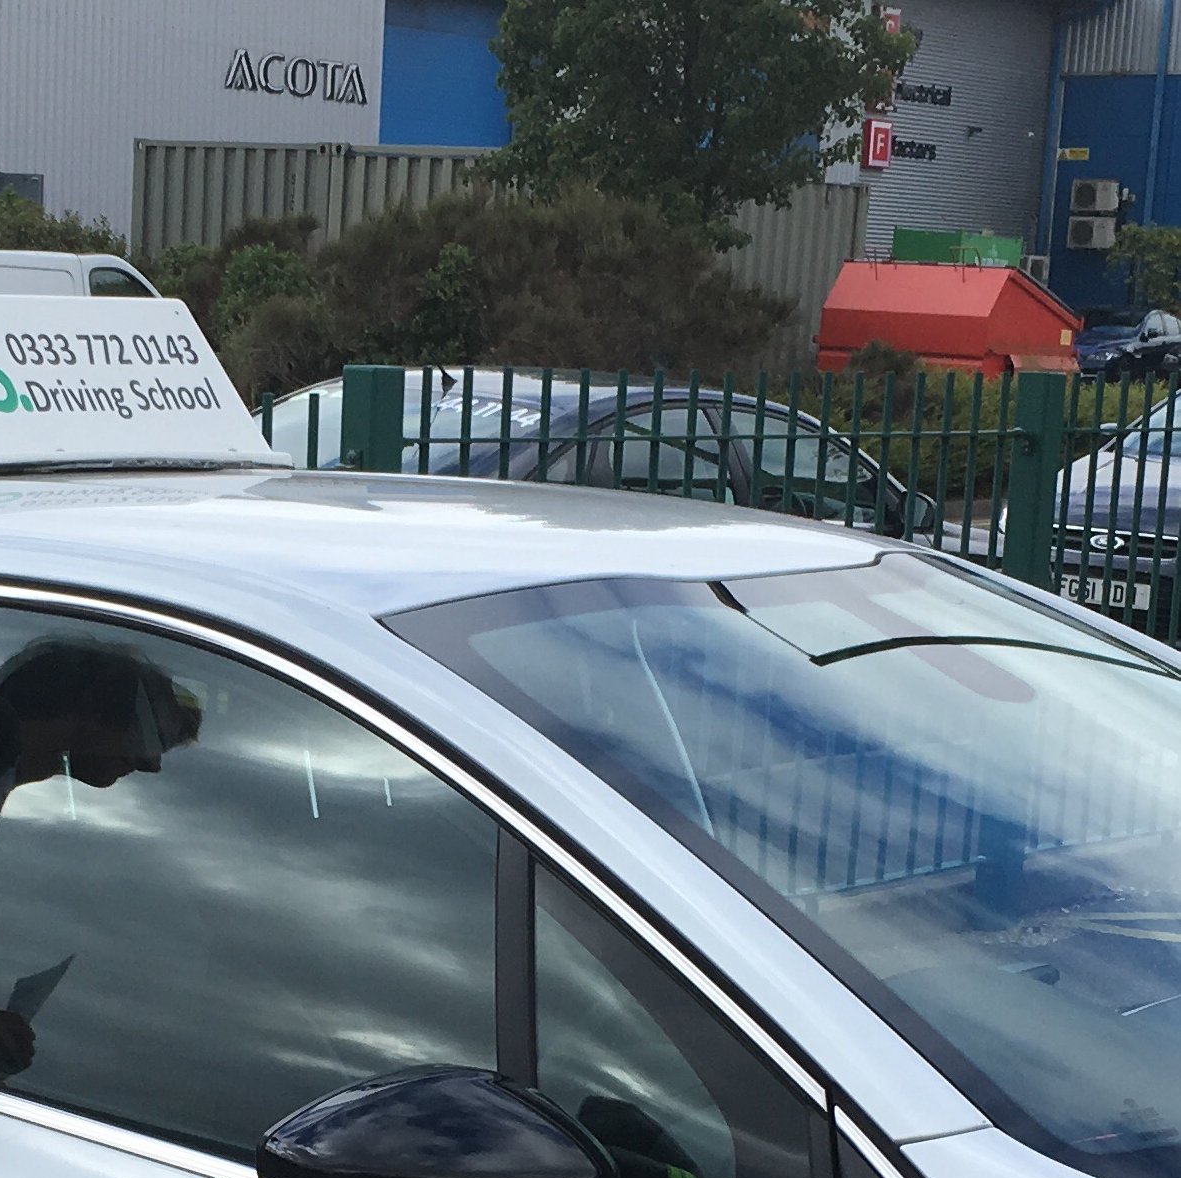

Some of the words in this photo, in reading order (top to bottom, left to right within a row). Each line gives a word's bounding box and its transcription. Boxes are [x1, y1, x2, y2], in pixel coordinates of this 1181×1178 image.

[224, 48, 368, 106] ACOTA
[876, 133, 885, 155] F
[5, 333, 77, 366] 0333
[76, 334, 133, 366] 772
[131, 334, 199, 366] 0143
[25, 380, 133, 419] Driving
[129, 377, 221, 412] School
